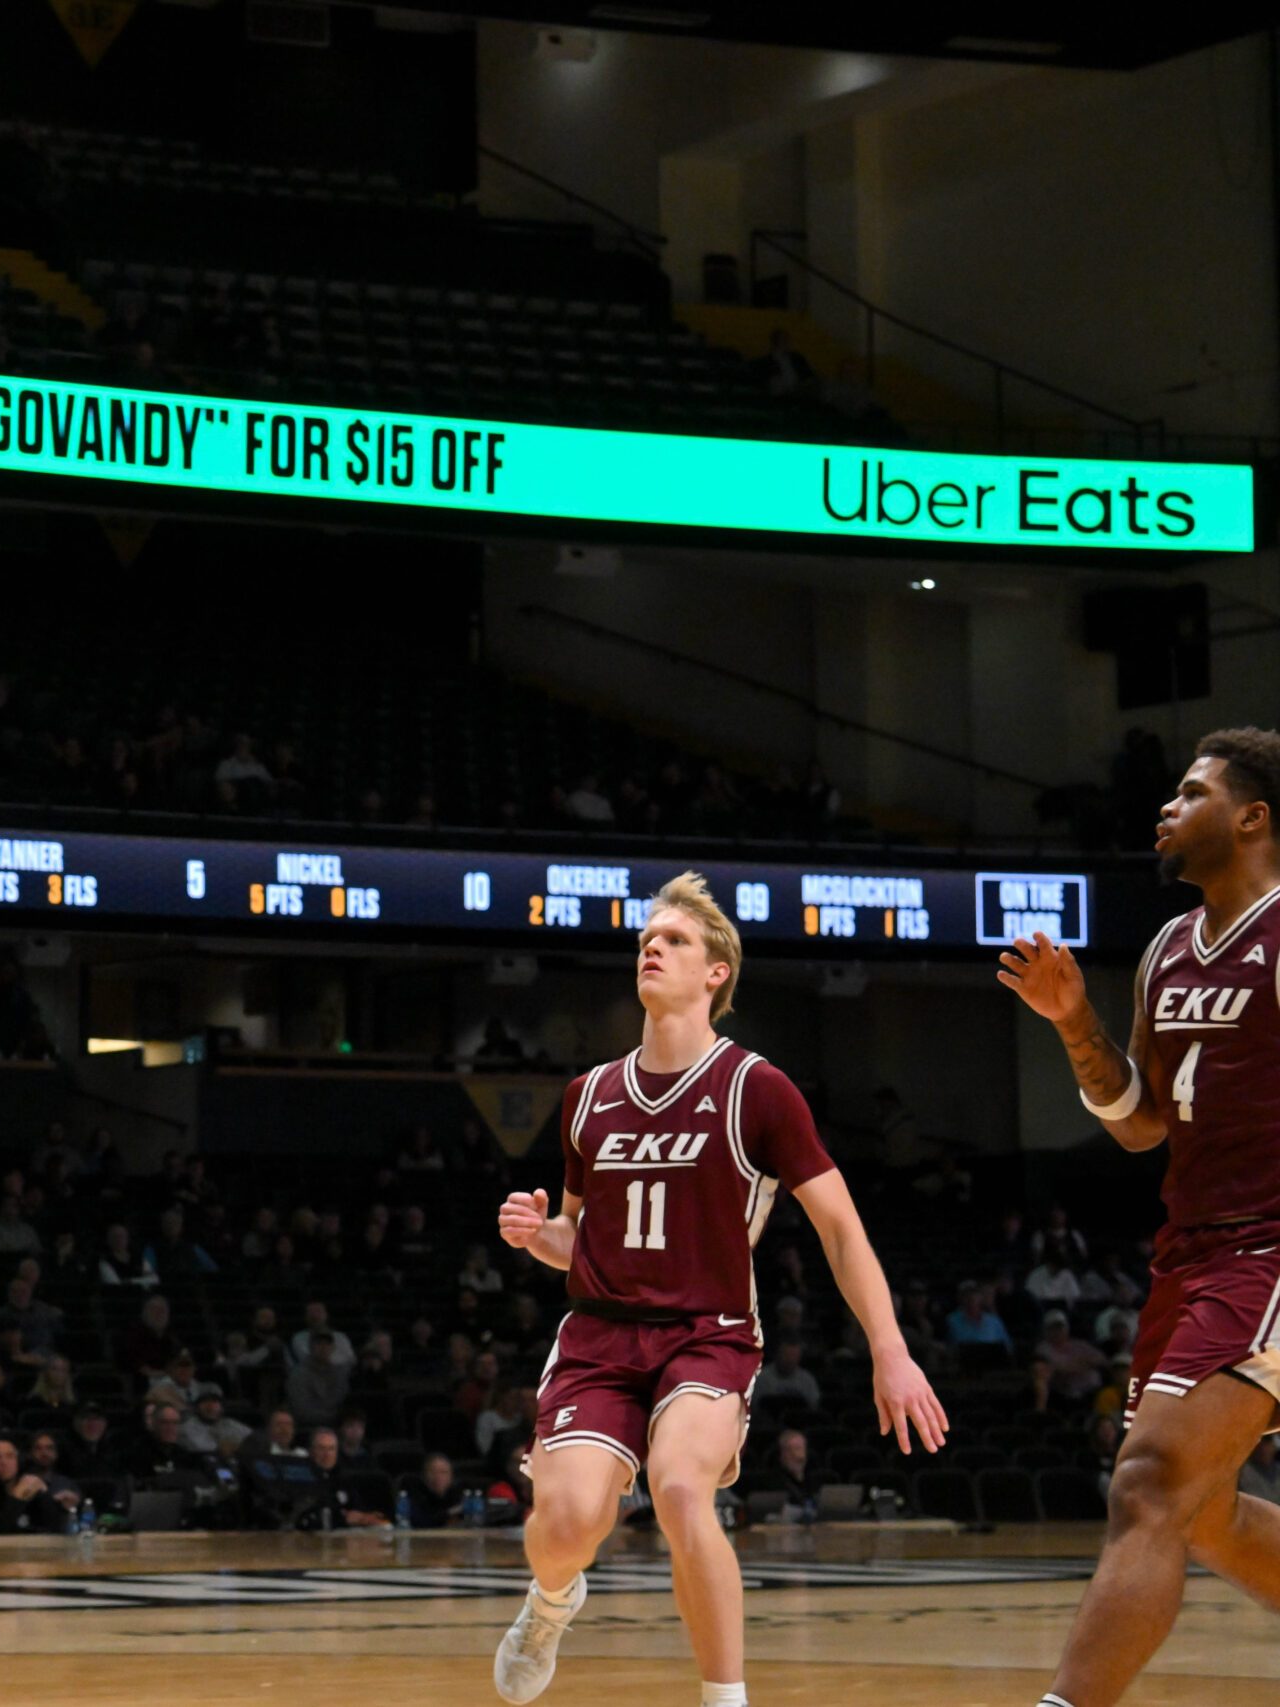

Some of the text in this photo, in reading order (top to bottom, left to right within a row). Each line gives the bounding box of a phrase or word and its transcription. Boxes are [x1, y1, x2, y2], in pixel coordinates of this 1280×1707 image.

[246, 412, 329, 481] FOR
[346, 419, 415, 486] $15
[431, 428, 505, 495] OFF
[823, 457, 1196, 537] Uber Eats
[186, 859, 206, 900] 5
[276, 853, 345, 886] NICKEL
[63, 874, 97, 906] FLS
[266, 884, 303, 916] PTS
[346, 887, 380, 919] FLS
[463, 871, 491, 912] 10
[736, 882, 770, 922] 99
[999, 879, 1065, 912] ON THE
[528, 895, 544, 926] 2
[544, 895, 581, 928] PTS
[611, 898, 621, 929] 1
[819, 906, 856, 937] PTS
[884, 909, 894, 939] 1
[896, 909, 930, 940] FLS
[1154, 987, 1254, 1022] EKU
[1172, 1041, 1203, 1122] 4
[595, 1133, 710, 1162] EKU
[624, 1180, 666, 1250] 11
